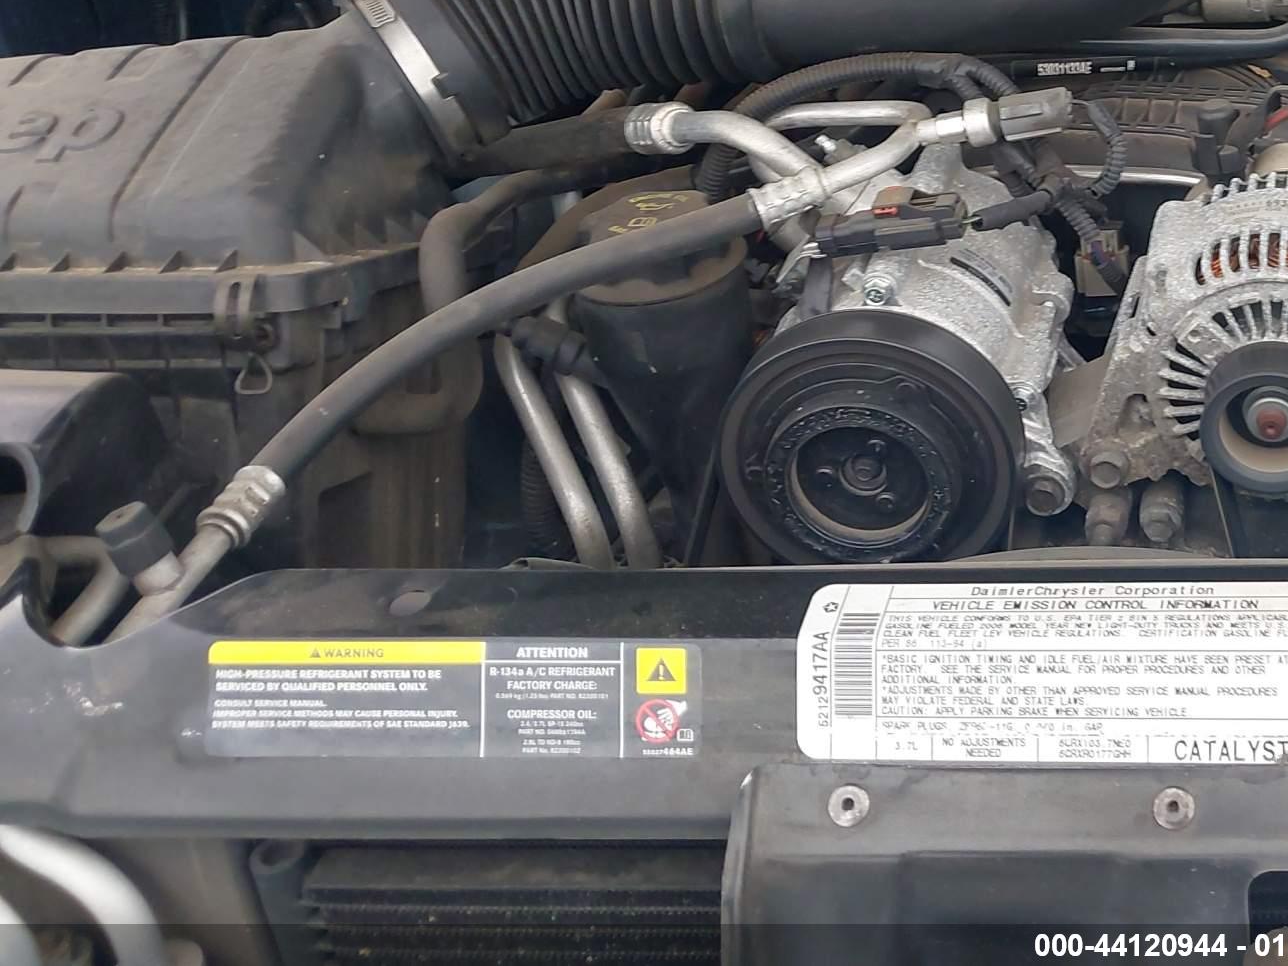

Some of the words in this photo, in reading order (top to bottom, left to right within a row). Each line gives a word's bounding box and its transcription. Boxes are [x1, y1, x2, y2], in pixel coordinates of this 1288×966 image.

[971, 585, 1105, 597] DaimlerChrysler
[1115, 585, 1215, 597] Corporation
[932, 600, 995, 610] VEHICLE
[1003, 600, 1077, 610] EMISSION
[1085, 600, 1148, 610] CONTROL
[1160, 600, 1260, 610] INFORMATION
[1018, 614, 1030, 622] TO
[324, 648, 384, 659] WARNING
[516, 646, 588, 658] ATTENTION
[924, 655, 970, 664] IGNITION
[976, 655, 1012, 664] TIMING
[1019, 655, 1036, 664] AND
[1043, 655, 1066, 664] IDLE
[1126, 655, 1168, 664] MIXTURE
[1174, 655, 1198, 664] HAVE
[1204, 655, 1229, 664] BEEN
[1235, 655, 1271, 664] PRESET
[1278, 655, 1288, 664] AT
[215, 669, 298, 679] HIGH-PRESSURE
[299, 669, 369, 679] REFRIGERANT
[370, 669, 411, 679] SYSTEM
[411, 669, 426, 679] TO
[428, 669, 441, 679] BE
[489, 666, 524, 676] R-134a
[525, 666, 547, 676] A/C
[548, 666, 616, 676] REFRIGERANT
[941, 665, 959, 674] SEE
[965, 665, 982, 674] THE
[988, 665, 1031, 674] SERVICE
[1036, 665, 1071, 674] MANUAL
[1078, 665, 1096, 674] FOR
[1101, 665, 1138, 674] PROPER
[1144, 665, 1205, 674] PROCEDURES
[1211, 665, 1229, 674] AND
[1235, 665, 1266, 674] OTHER
[812, 631, 830, 728] 52129417AA
[881, 675, 940, 684] ADDITIONAL
[215, 681, 265, 691] SERVICED
[266, 681, 281, 691] BY
[281, 681, 335, 691] QUALIFIED
[336, 681, 397, 691] PERSONNEL
[398, 681, 428, 691] ONLY.
[507, 680, 552, 690] FACTORY
[553, 680, 598, 690] CHARGE:
[958, 686, 983, 695] MADE
[988, 686, 1000, 695] BY
[1006, 686, 1037, 695] OTHER
[1042, 686, 1066, 695] THAN
[1073, 686, 1121, 695] APPROVED
[1126, 686, 1169, 695] SERVICE
[1175, 686, 1210, 695] MANUAL
[1216, 686, 1278, 695] PROCEDURES
[881, 696, 899, 705] MAY
[906, 696, 947, 705] VIOLATE
[952, 696, 994, 705] FEDERAL
[1001, 696, 1019, 705] AND
[1024, 696, 1055, 705] STATE
[507, 709, 575, 719] COMPRESSOR
[577, 709, 598, 719] OIL:
[935, 706, 964, 716] APPLY
[970, 706, 1013, 716] PARKING
[1019, 706, 1048, 716] BRAKE
[1055, 706, 1079, 716] WHEN
[1084, 706, 1139, 716] SERVICING
[276, 720, 307, 729] SAFETY
[372, 720, 385, 729] OF
[386, 720, 402, 729] SAE
[403, 720, 447, 729] STANDARD
[942, 737, 954, 747] NO
[960, 737, 1026, 747] ADJUSTMENTS
[966, 748, 1001, 758] NEEDED
